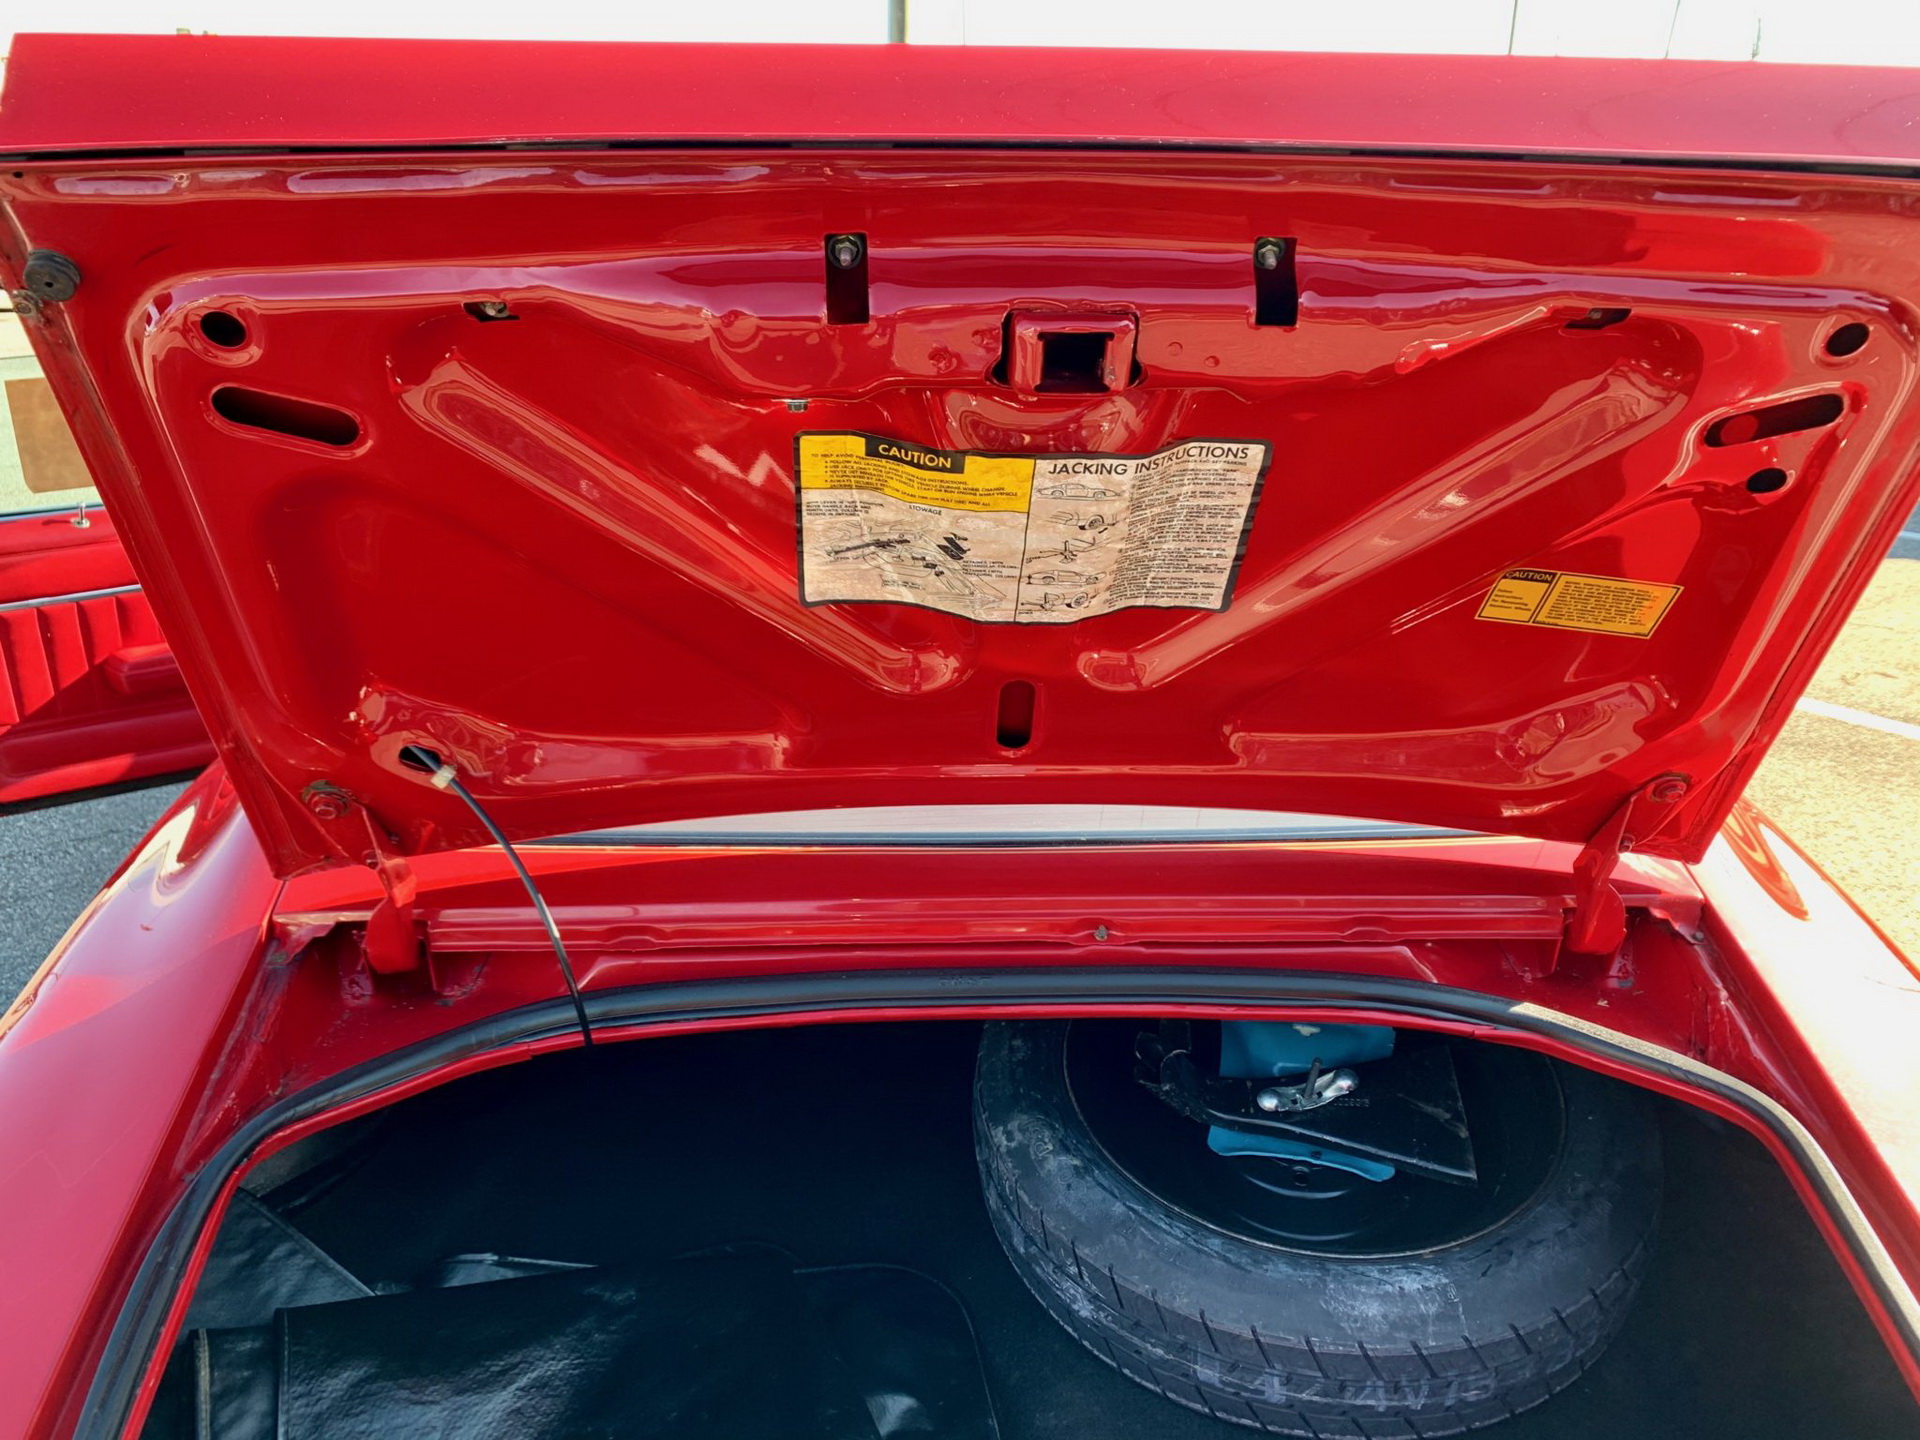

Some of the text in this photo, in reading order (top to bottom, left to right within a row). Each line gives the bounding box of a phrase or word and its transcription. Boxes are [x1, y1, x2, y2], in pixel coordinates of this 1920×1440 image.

[878, 444, 952, 468] CAUTION
[1048, 462, 1128, 475] JACKING
[1134, 446, 1248, 474] INSTRUCTIONS
[909, 504, 942, 516] STOWAGE
[1506, 571, 1553, 581] CAUTION
